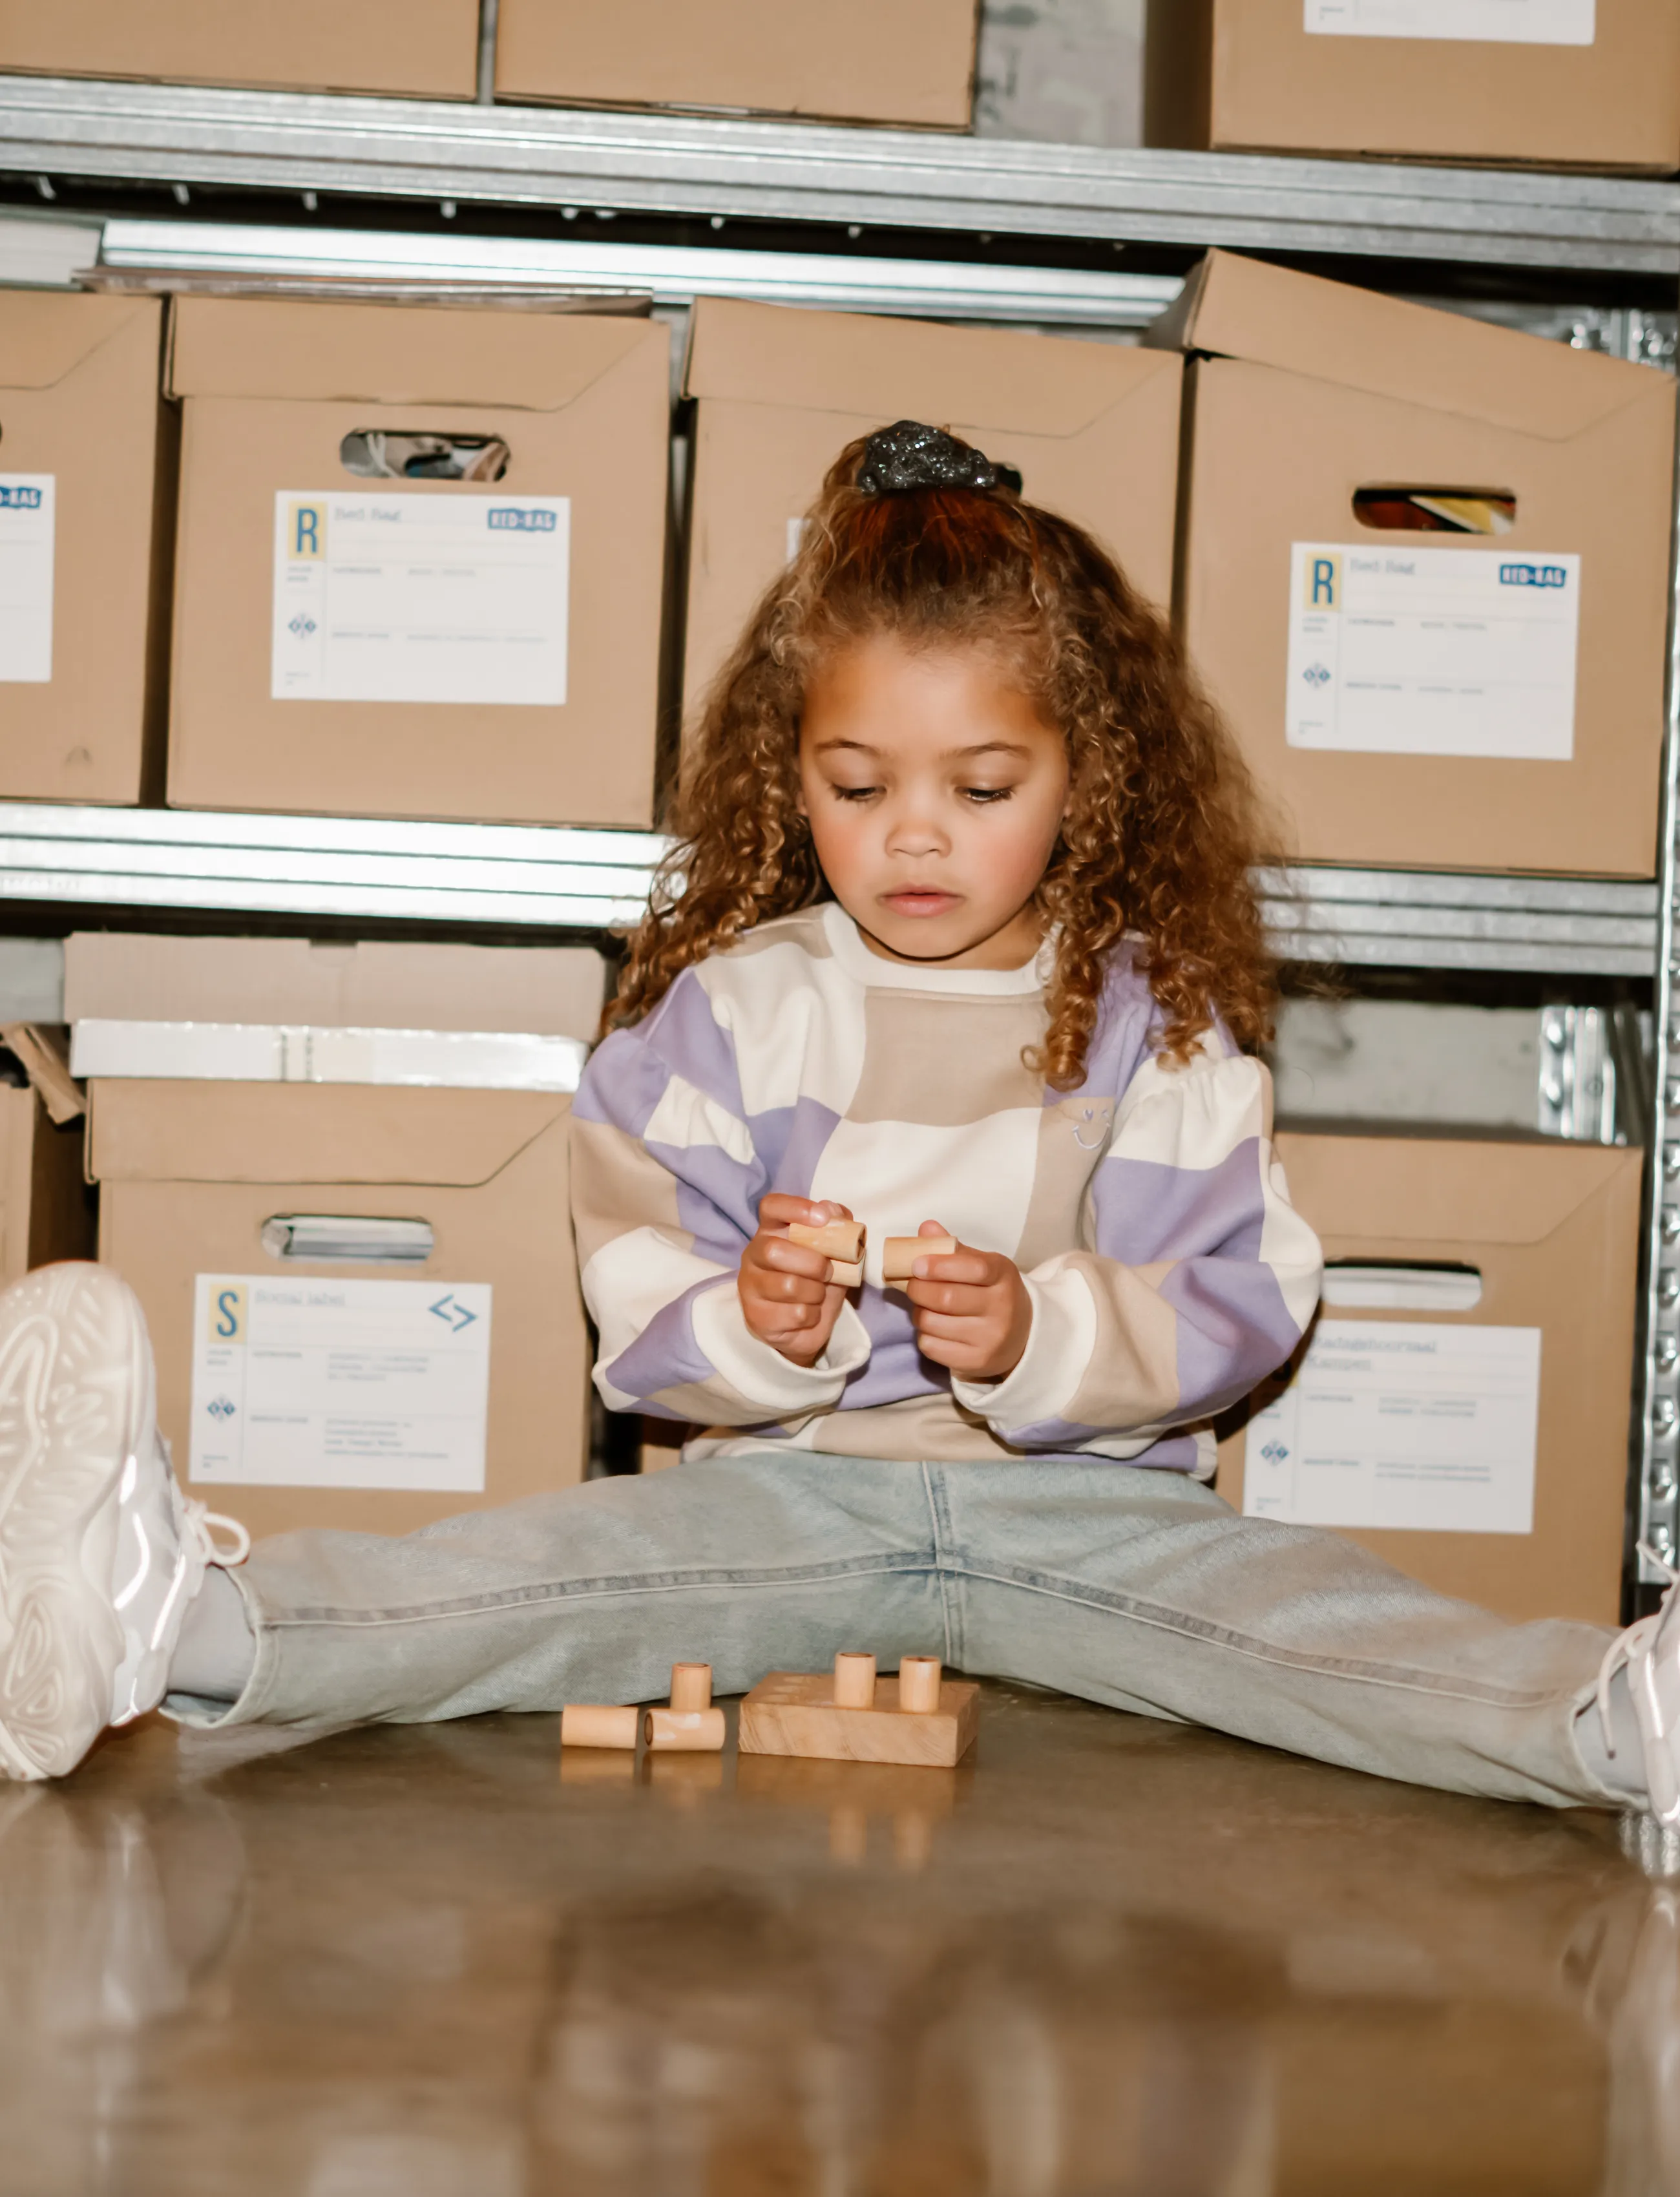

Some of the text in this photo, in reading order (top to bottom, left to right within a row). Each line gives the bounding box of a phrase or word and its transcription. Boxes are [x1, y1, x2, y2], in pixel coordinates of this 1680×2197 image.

[297, 509, 318, 553] R
[1312, 560, 1334, 604] R
[217, 1291, 238, 1337] S
